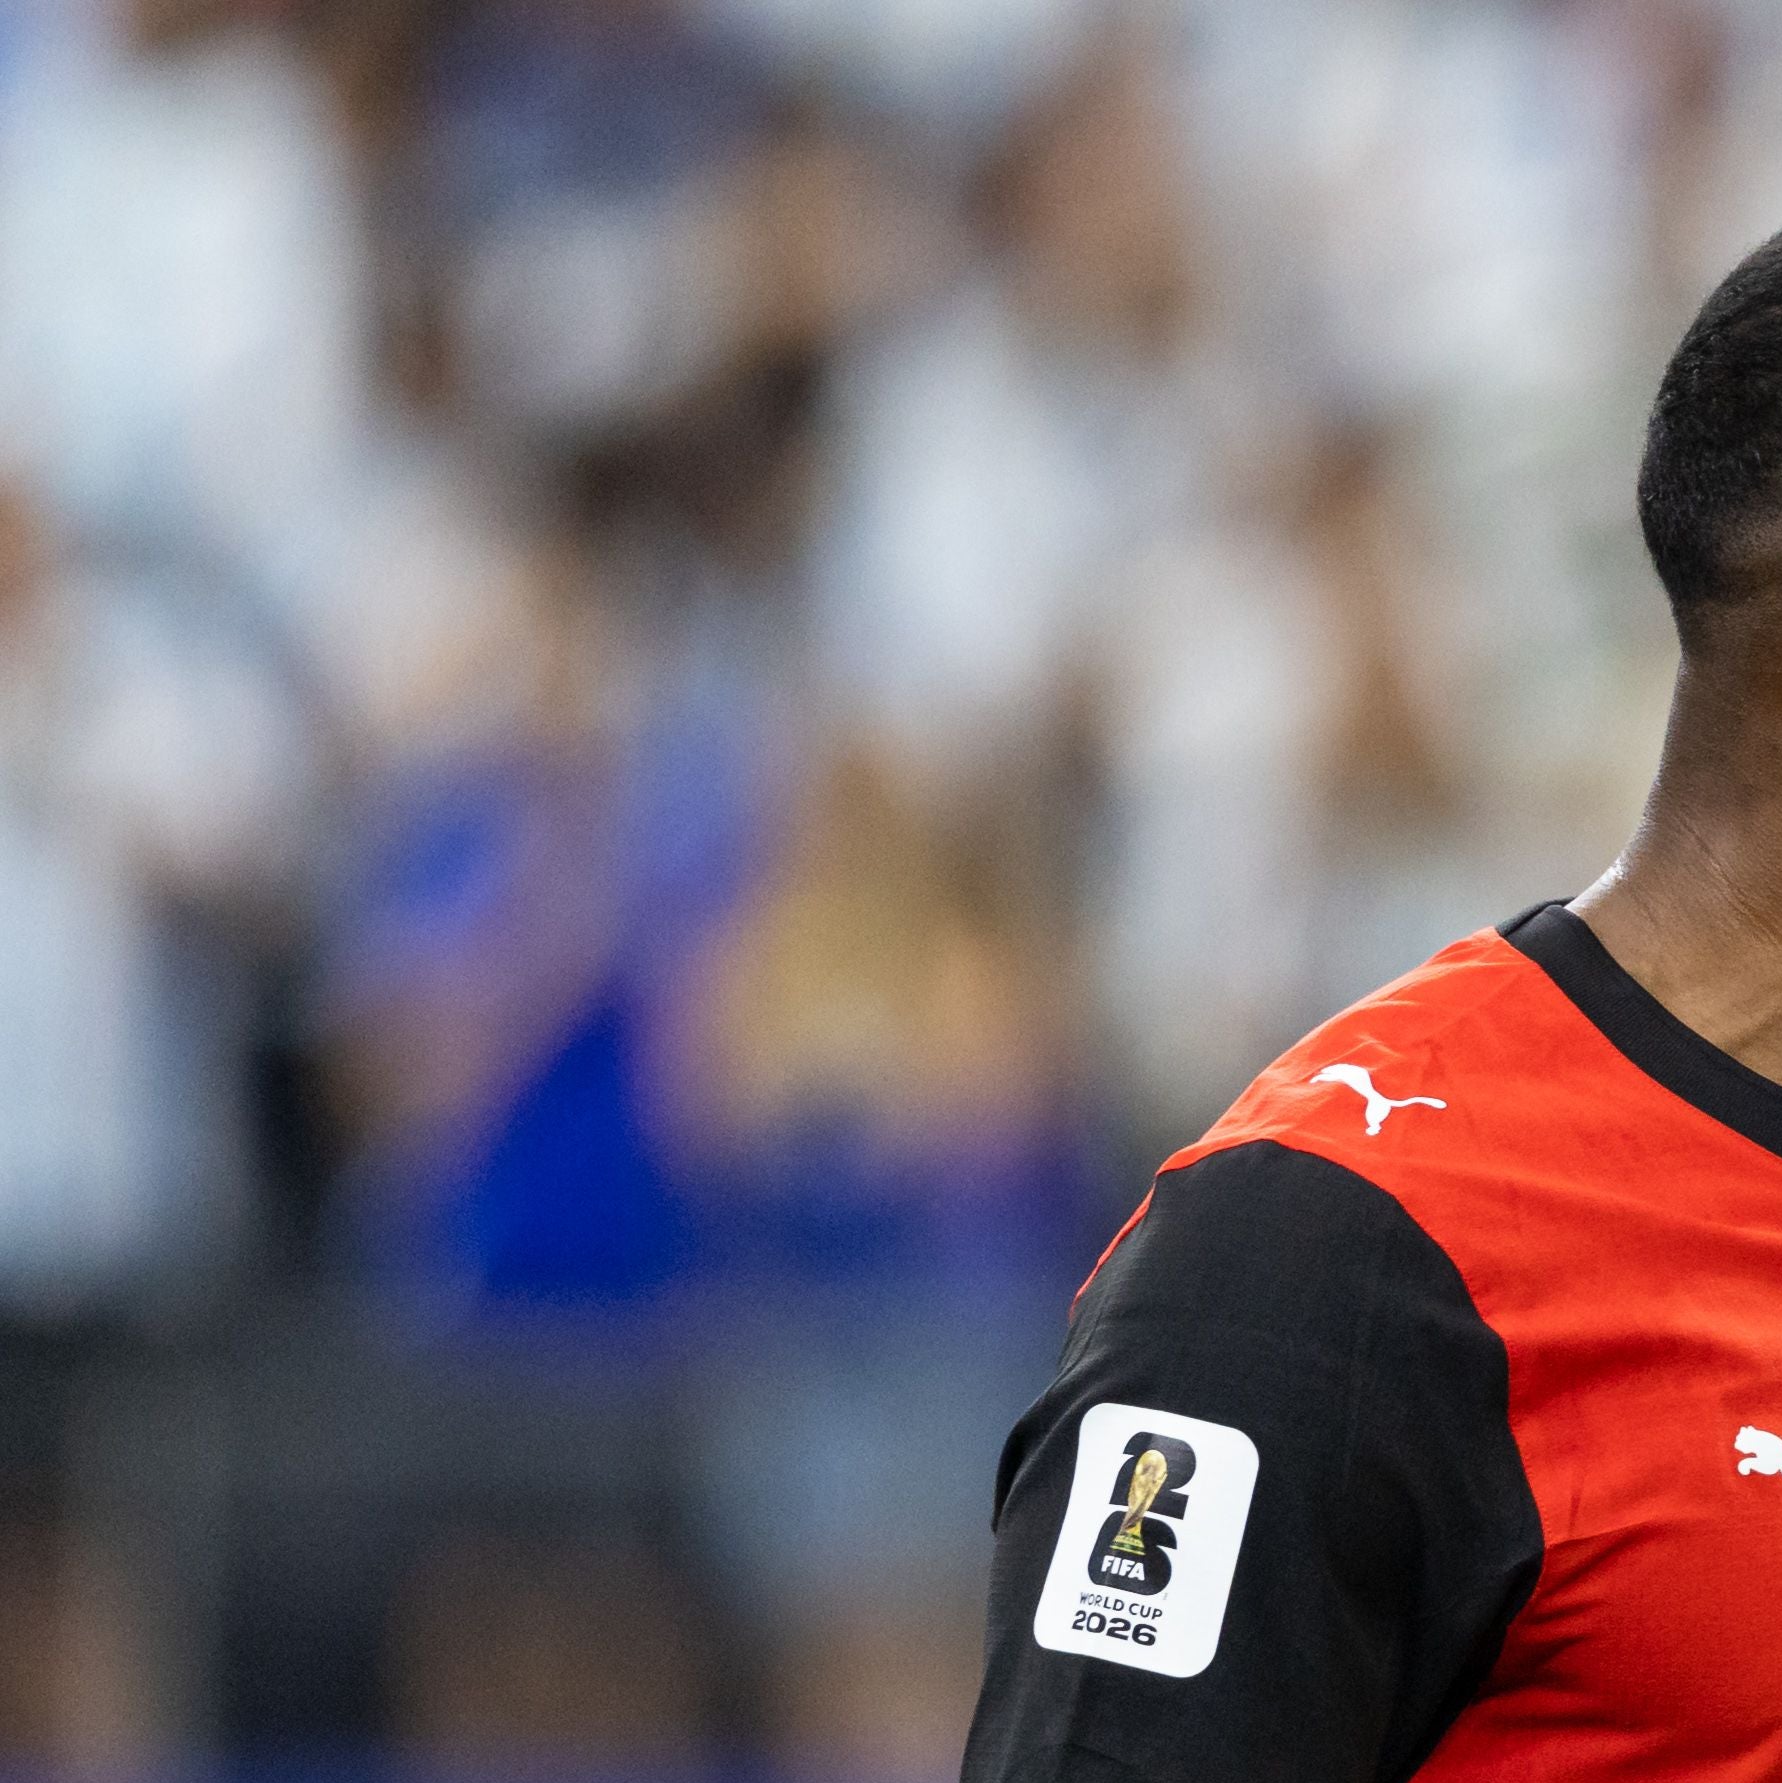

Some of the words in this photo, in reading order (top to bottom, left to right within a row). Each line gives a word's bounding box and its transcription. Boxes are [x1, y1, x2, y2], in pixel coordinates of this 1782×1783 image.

[1100, 1554, 1146, 1582] FIFA
[1079, 1591, 1125, 1612] WORLD
[1128, 1602, 1163, 1620] CUP
[1071, 1609, 1158, 1647] 2026
